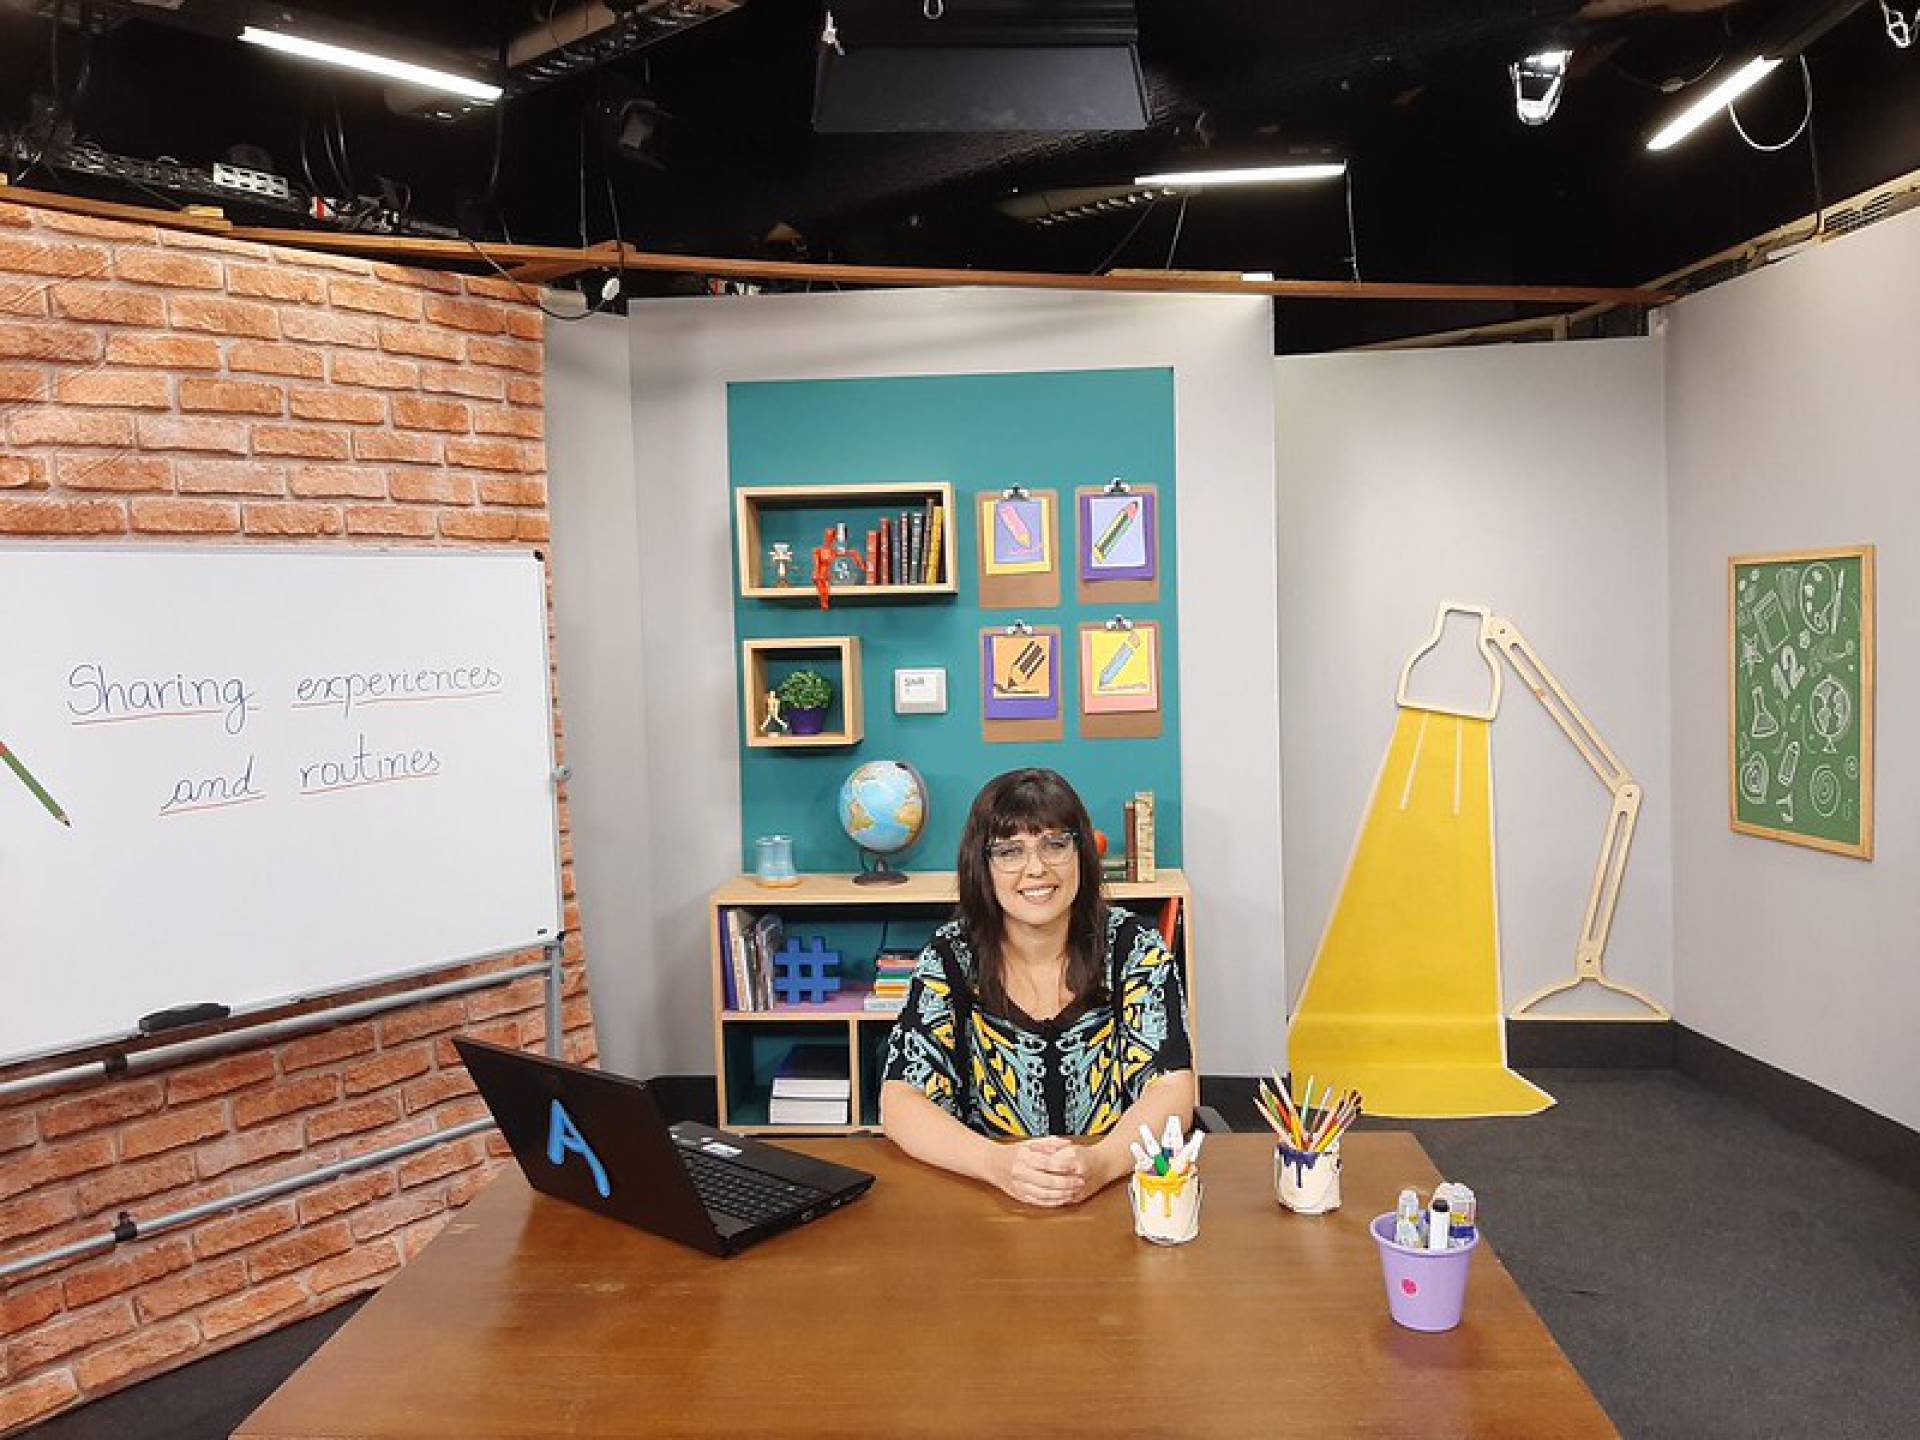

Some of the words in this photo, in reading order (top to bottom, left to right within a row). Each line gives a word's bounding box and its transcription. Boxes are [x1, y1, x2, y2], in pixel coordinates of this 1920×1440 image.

[67, 664, 255, 735] Sharing
[296, 665, 501, 717] experiences
[159, 754, 257, 813] and
[299, 733, 440, 789] routines
[547, 1098, 611, 1198] A
